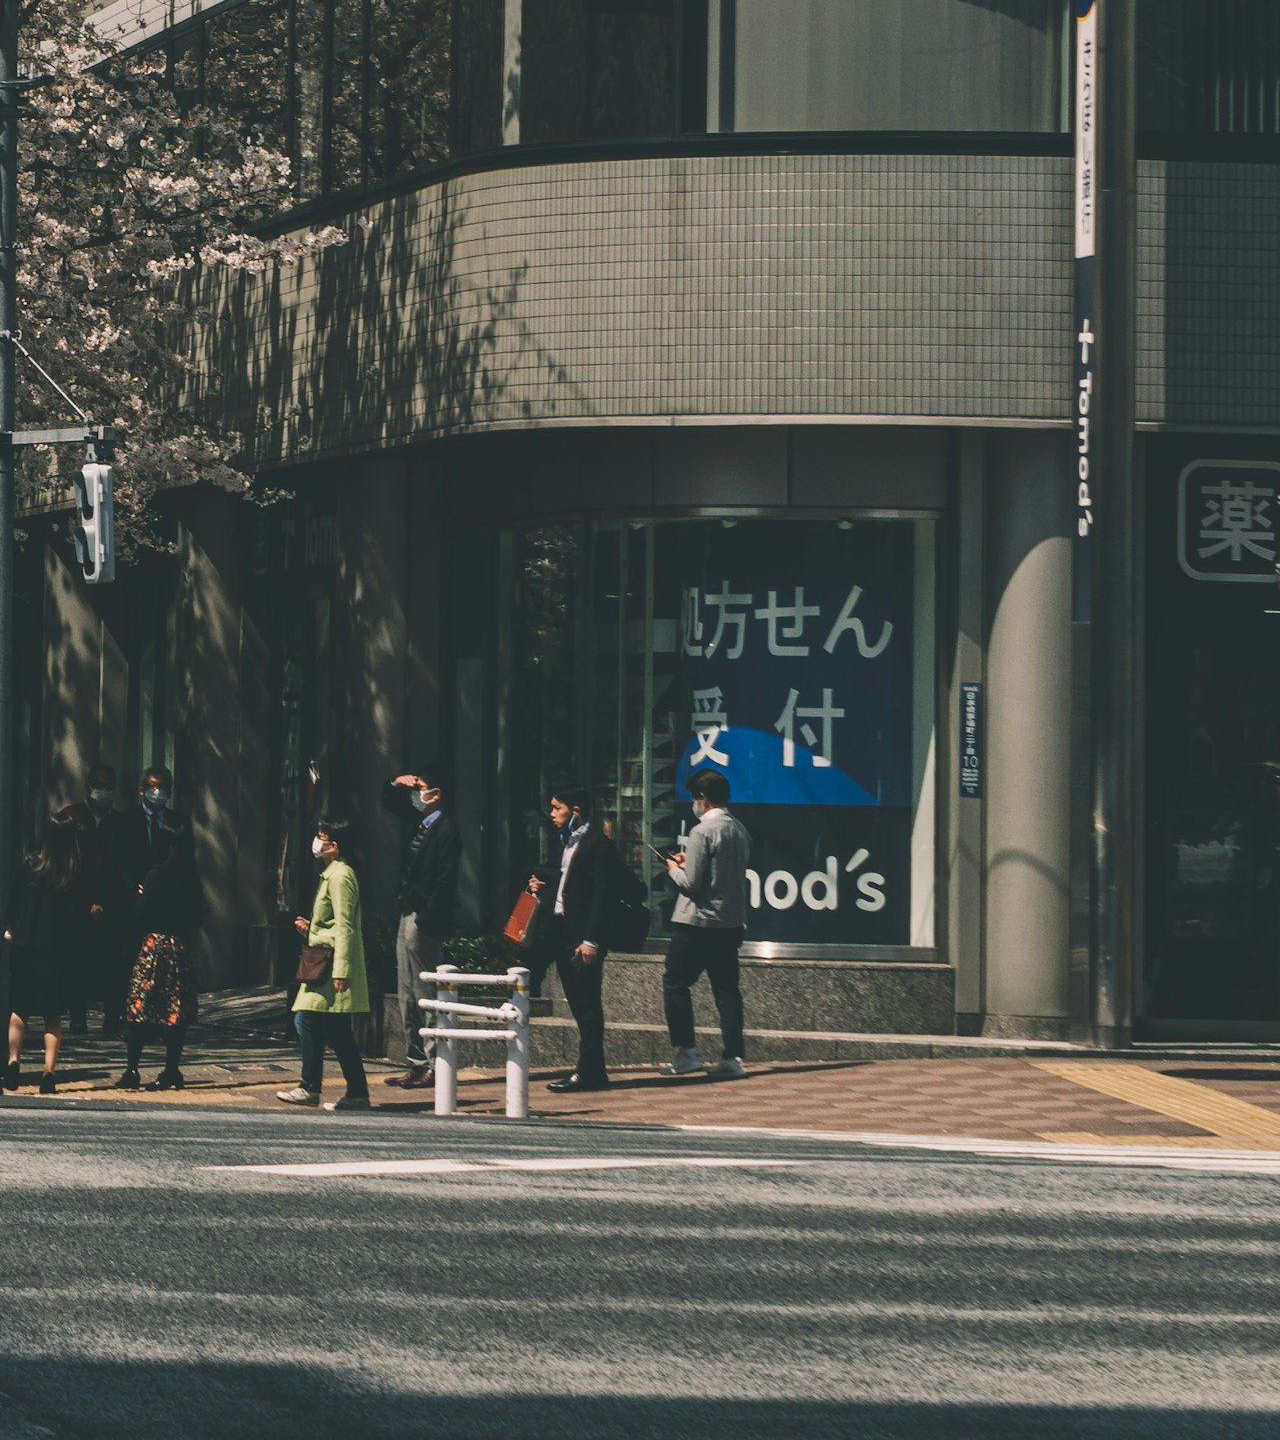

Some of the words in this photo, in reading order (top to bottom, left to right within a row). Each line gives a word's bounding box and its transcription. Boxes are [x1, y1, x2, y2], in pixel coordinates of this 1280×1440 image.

[1078, 371, 1093, 537] Tomod's
[1197, 479, 1277, 562] 薬
[680, 580, 894, 660] 処方せん
[963, 756, 979, 768] 10
